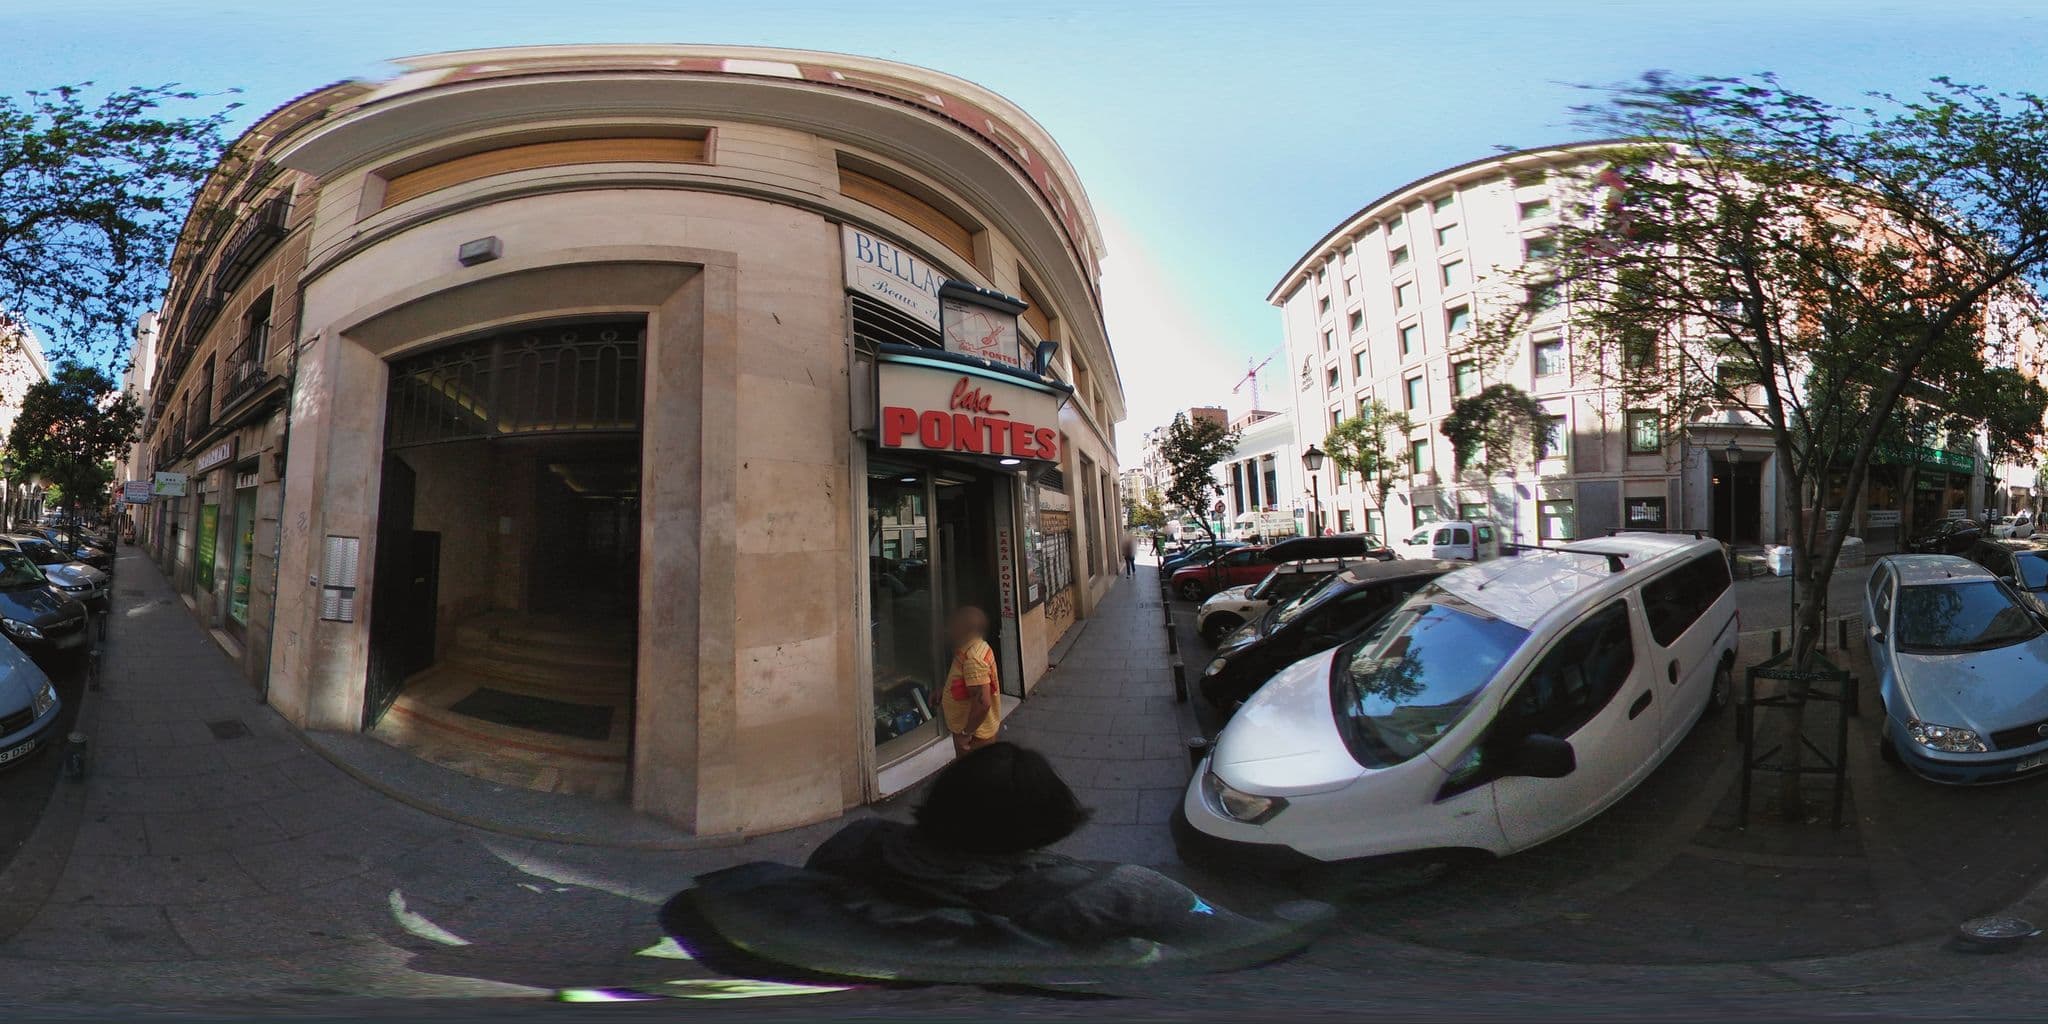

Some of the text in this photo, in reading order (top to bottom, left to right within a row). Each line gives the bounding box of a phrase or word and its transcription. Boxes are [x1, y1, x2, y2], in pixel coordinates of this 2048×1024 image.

[982, 349, 1018, 365] PONTES
[951, 376, 1010, 416] Casa
[884, 406, 1056, 459] PONTES
[1000, 530, 1009, 561] CASA
[1001, 565, 1012, 612] PONTES
